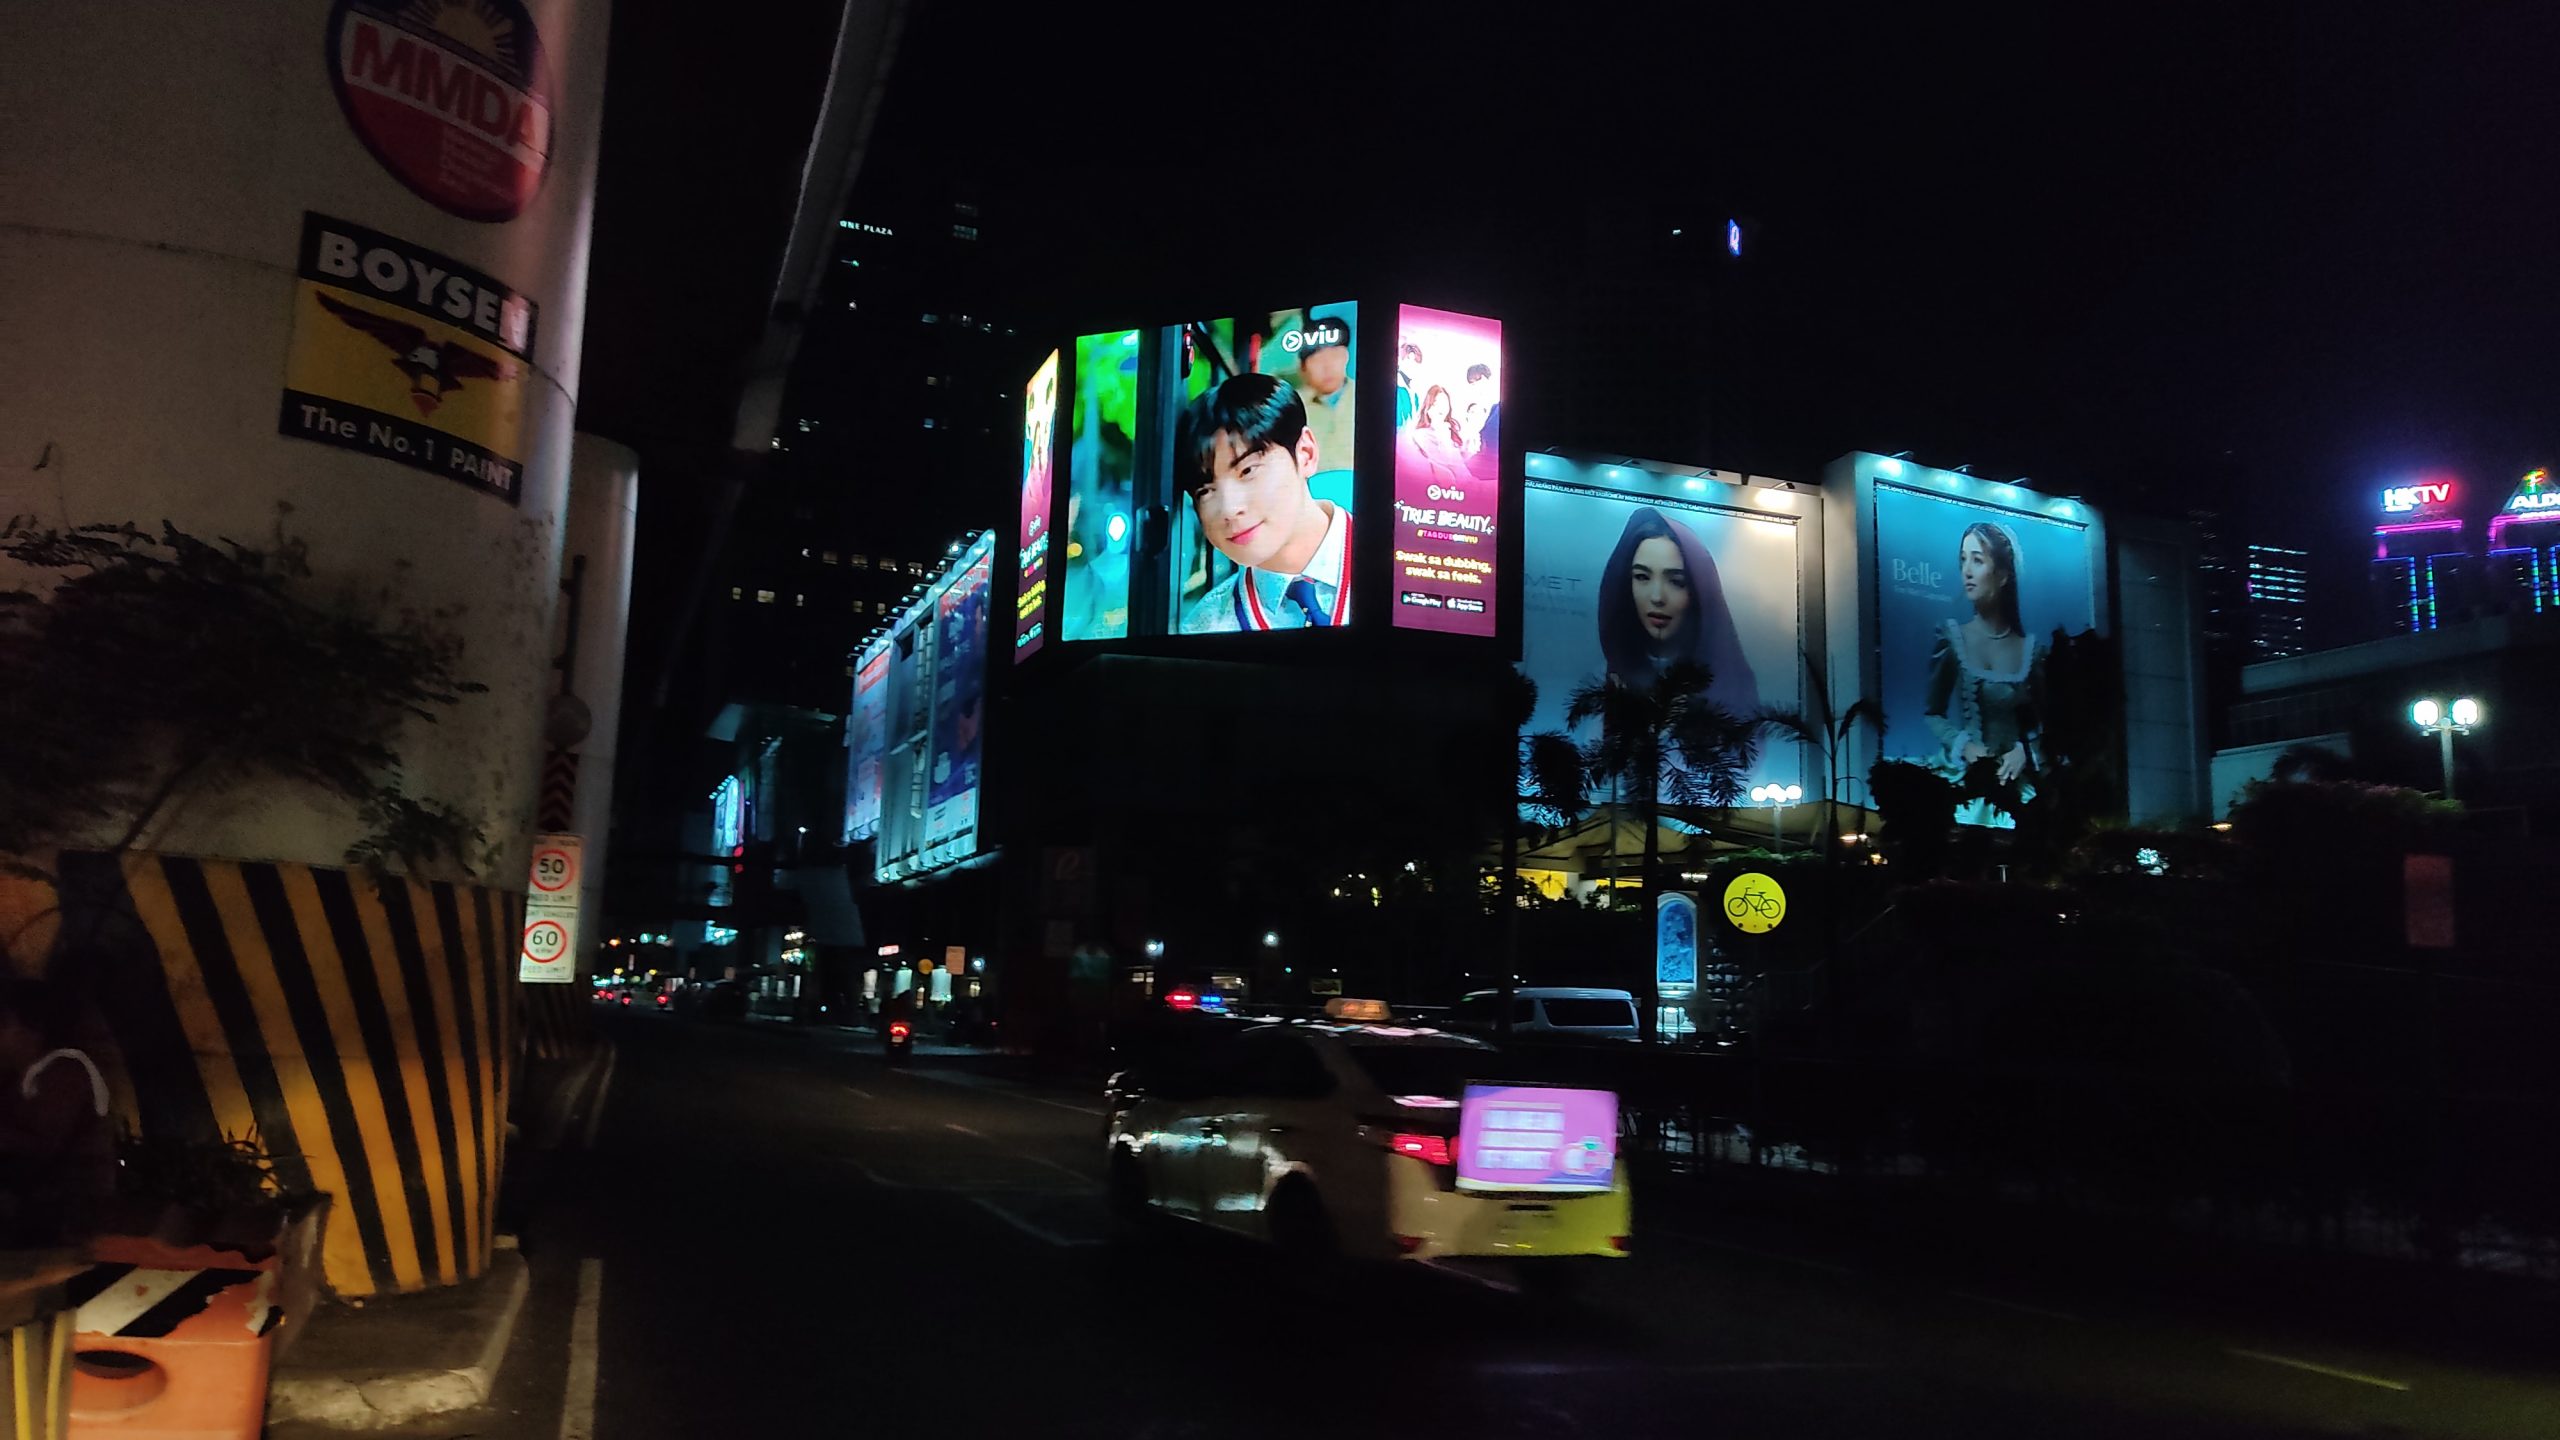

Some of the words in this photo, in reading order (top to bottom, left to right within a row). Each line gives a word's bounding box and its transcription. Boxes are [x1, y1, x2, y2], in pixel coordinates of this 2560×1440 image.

[351, 22, 536, 147] MMDA
[863, 224, 893, 236] PLAZA
[1303, 324, 1340, 346] viu
[300, 403, 357, 439] The
[450, 447, 514, 491] PAINT
[1441, 486, 1465, 501] viu
[1401, 505, 1436, 525] TRUE
[1437, 510, 1491, 533] BEAUTY
[1395, 550, 1427, 564] Swak
[1428, 555, 1442, 566] sa
[1893, 558, 1942, 588] Belle
[539, 858, 565, 874] 50
[532, 929, 559, 947] 60
